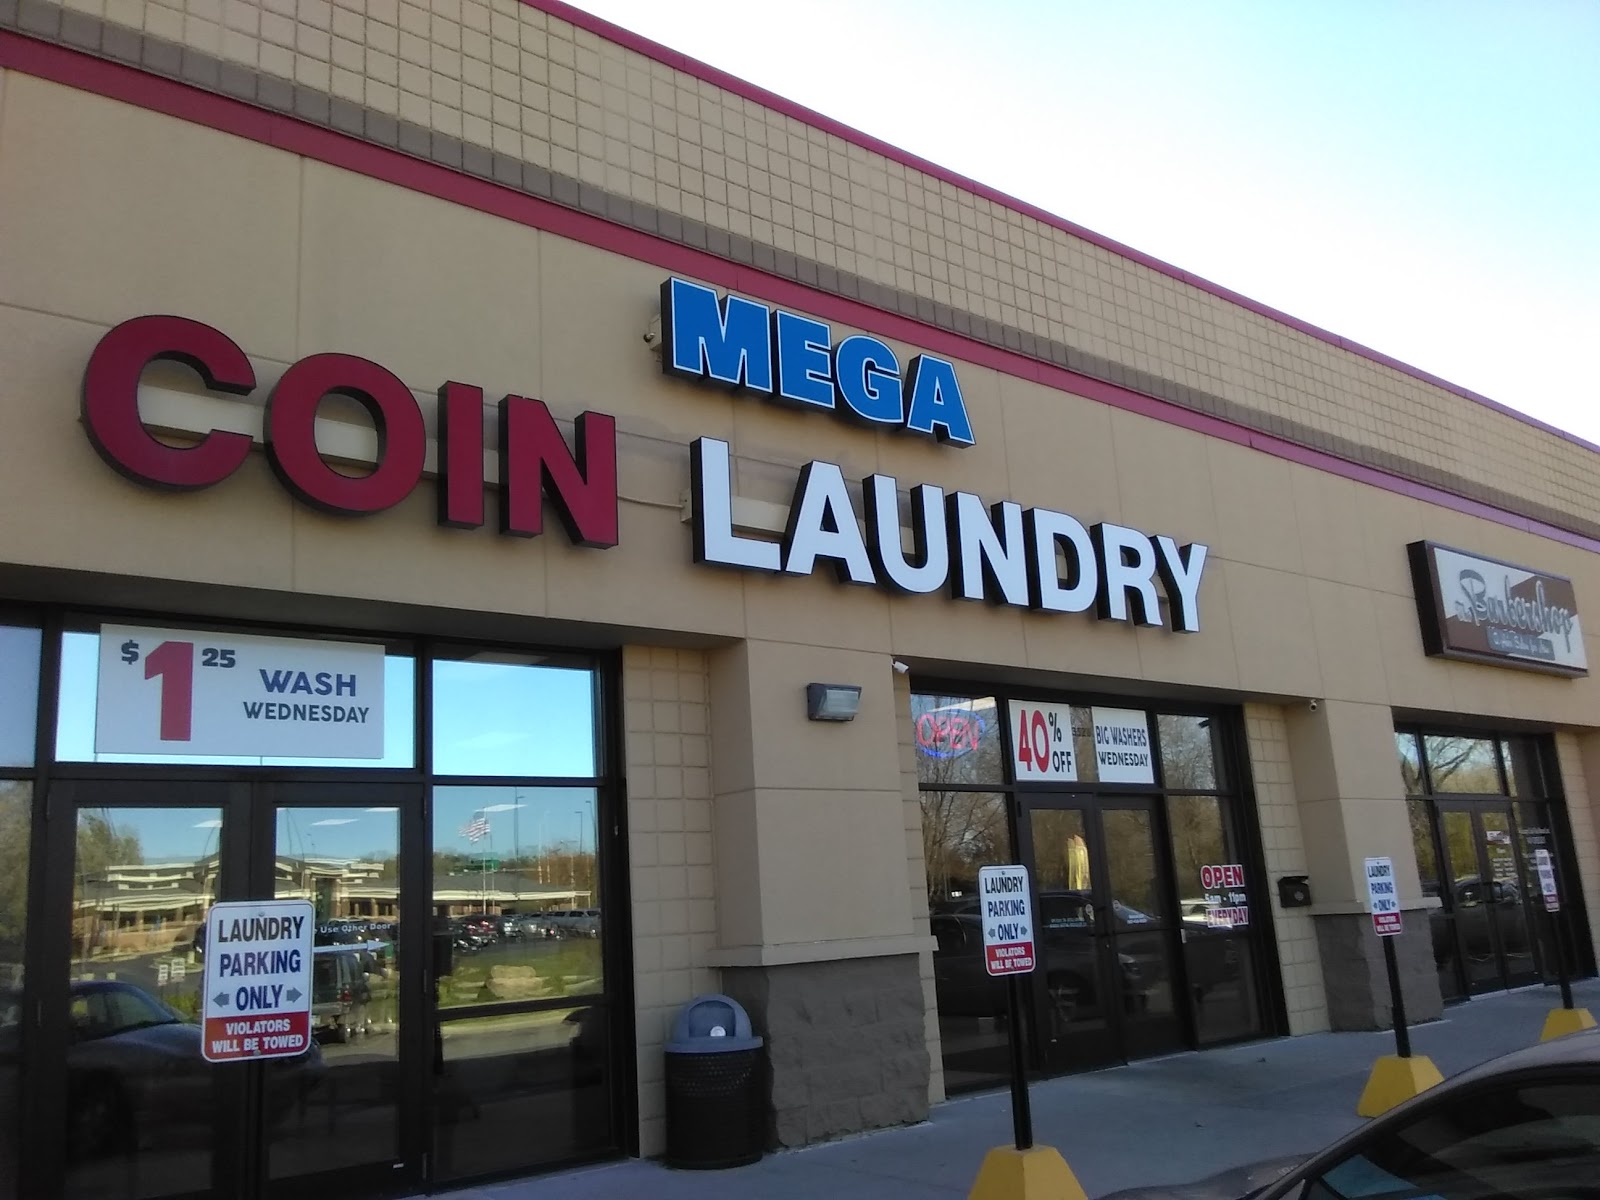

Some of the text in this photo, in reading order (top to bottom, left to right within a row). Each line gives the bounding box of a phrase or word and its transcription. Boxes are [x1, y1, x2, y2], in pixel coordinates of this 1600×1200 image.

[664, 276, 976, 447] MEGA
[83, 315, 1208, 632] COIN LAUNDRY
[259, 669, 357, 697] WASH
[243, 702, 369, 723] WEDNESDAY
[917, 713, 980, 751] OPEN
[1096, 725, 1147, 746] BIG WASHERS
[1052, 751, 1071, 773] OFF
[1099, 750, 1148, 767] WEDNESDAY
[984, 876, 1024, 894] LAUNDRY
[1200, 864, 1245, 889] OPEN
[987, 899, 1026, 917] PARKING
[218, 916, 304, 943] LAUNDRY
[320, 925, 339, 934] Use
[341, 923, 368, 934] Other
[369, 922, 392, 931] Door
[997, 923, 1019, 941] ONLY
[995, 946, 1026, 958] VIOLATORS
[219, 949, 301, 977] PARKING
[990, 960, 1004, 970] WILL
[236, 984, 284, 1011] ONLY
[226, 1018, 291, 1035] VIOLATORS
[212, 1034, 304, 1053] WILL BE TOWED
